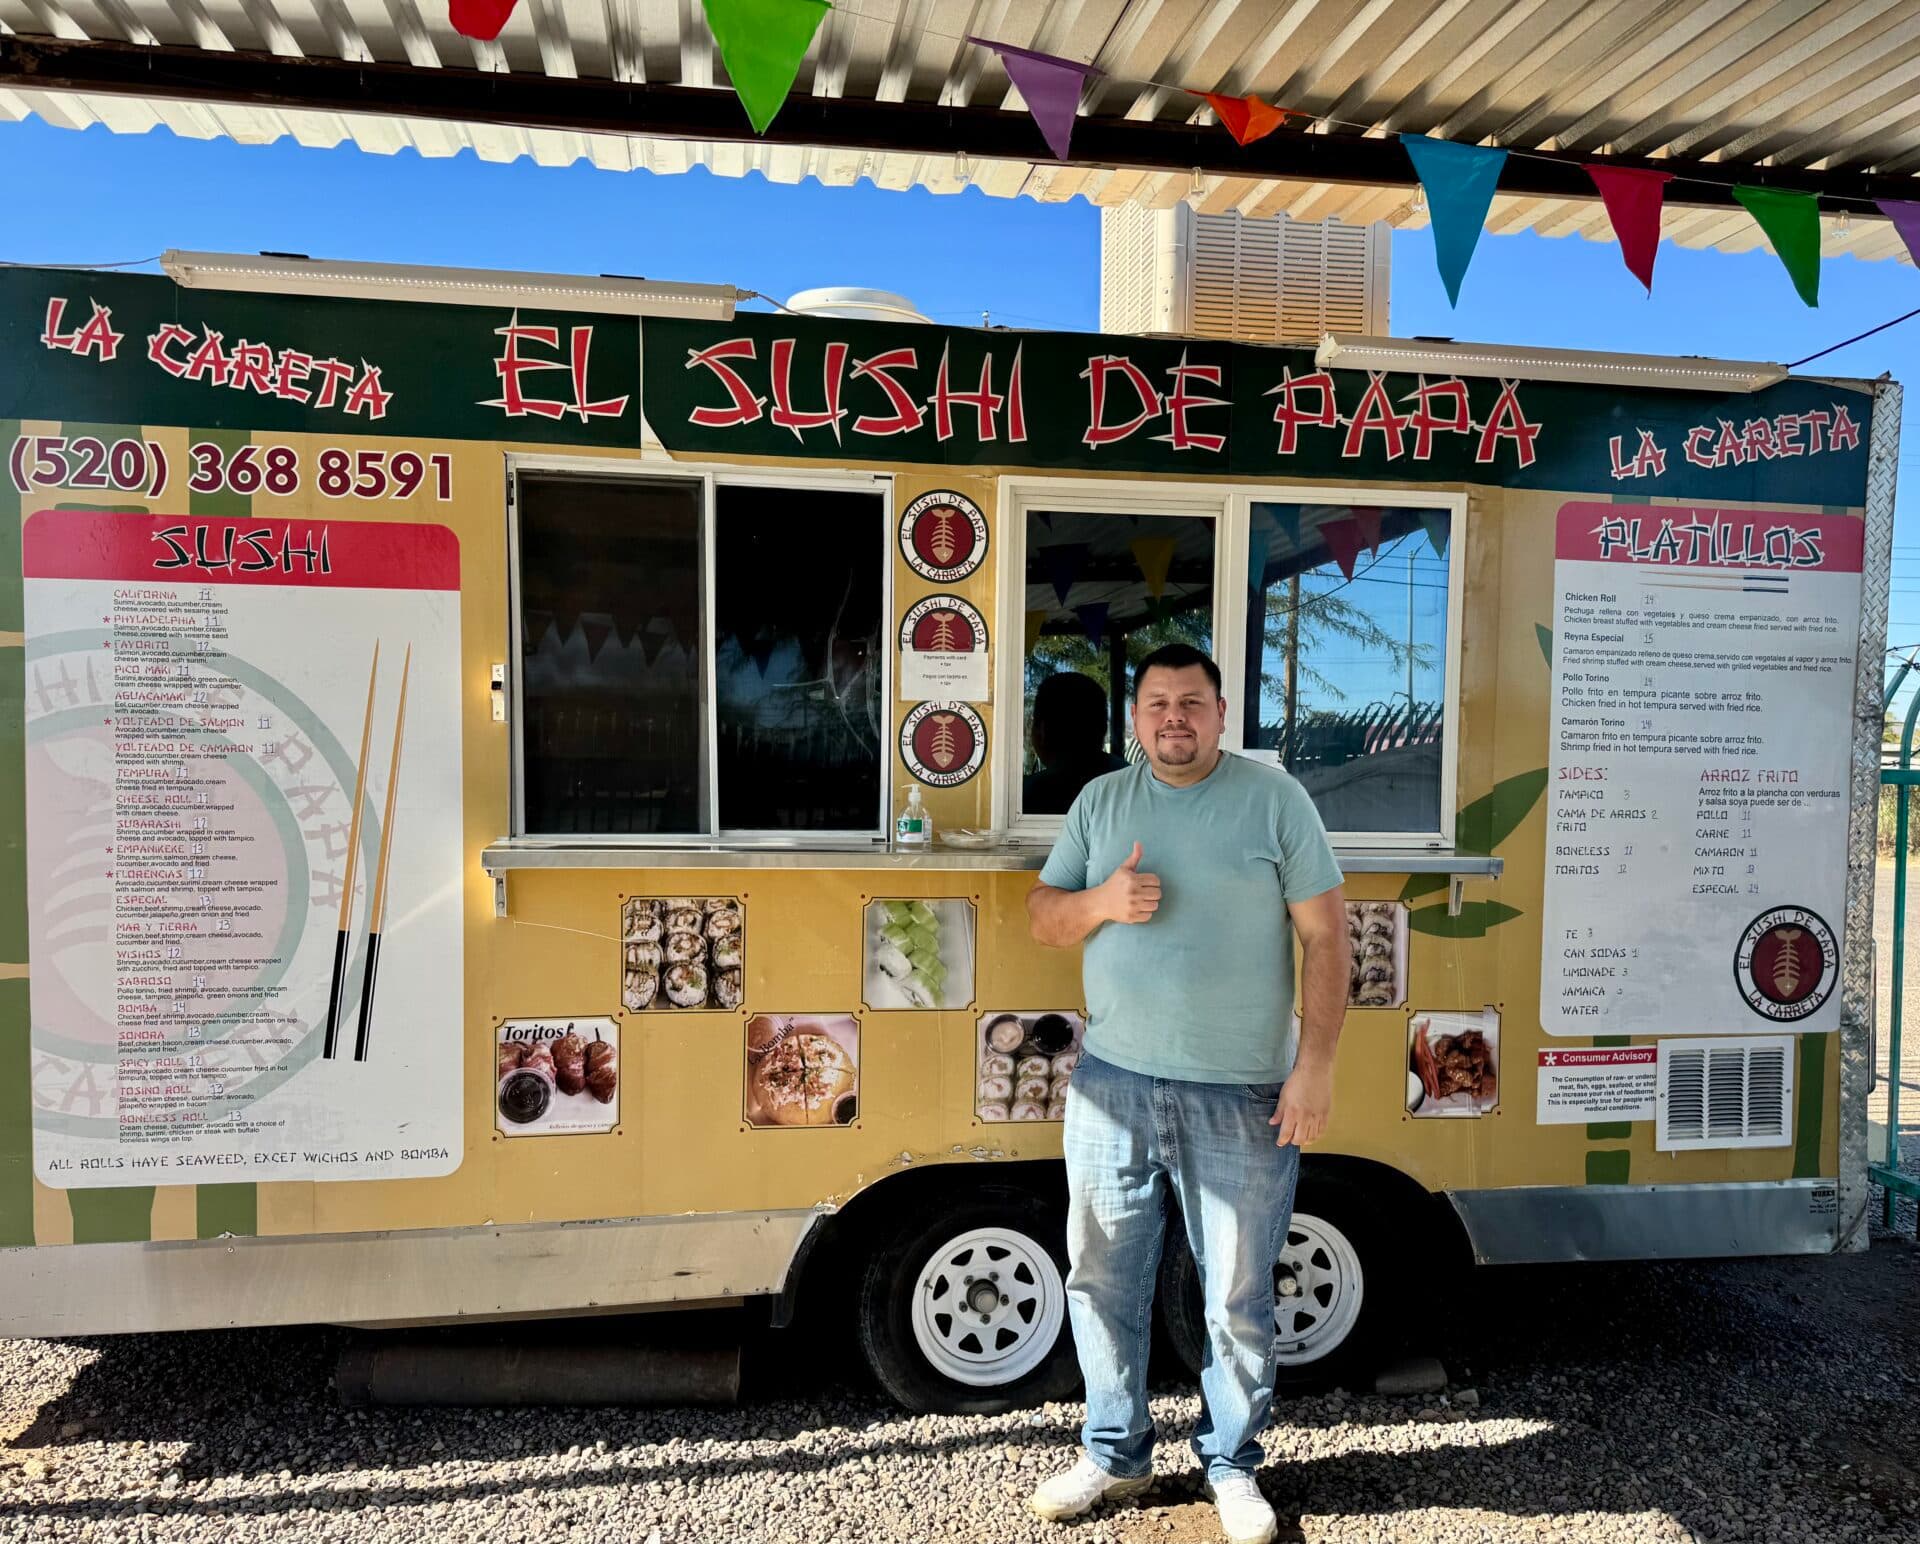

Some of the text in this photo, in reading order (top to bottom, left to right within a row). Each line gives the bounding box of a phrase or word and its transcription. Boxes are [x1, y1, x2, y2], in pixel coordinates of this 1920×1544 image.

[40, 296, 393, 420] LA CARETA
[478, 306, 1543, 469] EL SUSHI DE PAPA
[1610, 401, 1861, 481] LA CARETA
[9, 436, 453, 499] (520) 368 8591
[903, 495, 984, 541] EL SUSHI DE PAPA
[1588, 510, 1825, 569] PLATILLOS
[152, 525, 330, 575] SUSHI
[911, 557, 975, 580] LA CARRETA
[114, 590, 177, 600] CALIFORNIA
[1565, 593, 1598, 601] Chicken
[1601, 594, 1616, 602] Roll
[114, 616, 195, 625] PHYLADELPHIA
[903, 599, 984, 644] EL SUSHI DE PAPA
[1565, 632, 1588, 642] Reyna
[1592, 634, 1623, 642] Especial
[178, 666, 189, 676] 11
[1563, 673, 1609, 682] Pollo Torino
[115, 692, 206, 702] AGUACAMAKI 12
[1563, 687, 1583, 695] Pollo
[1588, 688, 1603, 696] frito
[1623, 690, 1656, 698] tempura
[1661, 691, 1690, 700] picante
[180, 718, 194, 726] DE
[200, 718, 244, 726] SALMON
[903, 701, 984, 746] EL SUSHI DE PAPA
[180, 744, 194, 752] DE
[200, 744, 253, 752] CAMARON
[117, 769, 168, 778] TEMPURA
[911, 762, 975, 784] LA CARRETA
[1559, 767, 1608, 780] SIDES:
[1701, 769, 1798, 782] ARROZ FRITO
[1560, 790, 1603, 799] TAMPICO
[1699, 788, 1720, 796] Arroz
[1723, 788, 1737, 796] frito
[1757, 789, 1787, 798] plancha
[1807, 790, 1840, 798] verduras
[1557, 809, 1658, 819] CAMA DE ARROS 2
[1697, 811, 1727, 819] POLLO
[117, 820, 181, 828] SUBARASHI
[1556, 823, 1586, 831] FRITO
[1696, 829, 1729, 838] CARNE
[1556, 847, 1609, 855] BONELESS
[1695, 848, 1744, 856] CAMARON
[116, 870, 182, 878] FLORENCIAS
[1556, 866, 1599, 874] TORITOS
[1694, 867, 1724, 875] MIXTO
[1693, 885, 1739, 893] ESPECIAL
[116, 896, 167, 904] ESPECIAL
[159, 923, 197, 931] TIERRA
[219, 920, 231, 930] 13
[1565, 930, 1578, 939] TE
[1740, 912, 1835, 969] EL SUSHI DE PAPA
[169, 949, 180, 958] 12
[1564, 948, 1626, 958] CAN SODAS
[1563, 967, 1615, 976] LIMONADE
[118, 977, 206, 987] SABROSO 14
[1562, 987, 1605, 996] JAMAICA
[174, 1002, 185, 1012] 14
[1749, 990, 1823, 1017] LA CARRETA
[1562, 1006, 1598, 1015] WATER
[504, 1024, 564, 1040] Toritos
[1563, 1052, 1652, 1062] Consumer Advisory
[120, 1059, 149, 1067] SPICY
[156, 1058, 182, 1066] ROLL
[120, 1087, 160, 1095] TOSINO
[209, 1085, 224, 1094] 13
[120, 1112, 242, 1123] BONELESS ROLL 13
[49, 1160, 72, 1170] ALL
[80, 1158, 124, 1169] ROLLS
[176, 1154, 247, 1165] SEAWEED,
[254, 1153, 296, 1163] EXCET
[303, 1152, 358, 1163] WICHOS
[365, 1151, 393, 1161] AND
[400, 1148, 448, 1159] BOMBA
